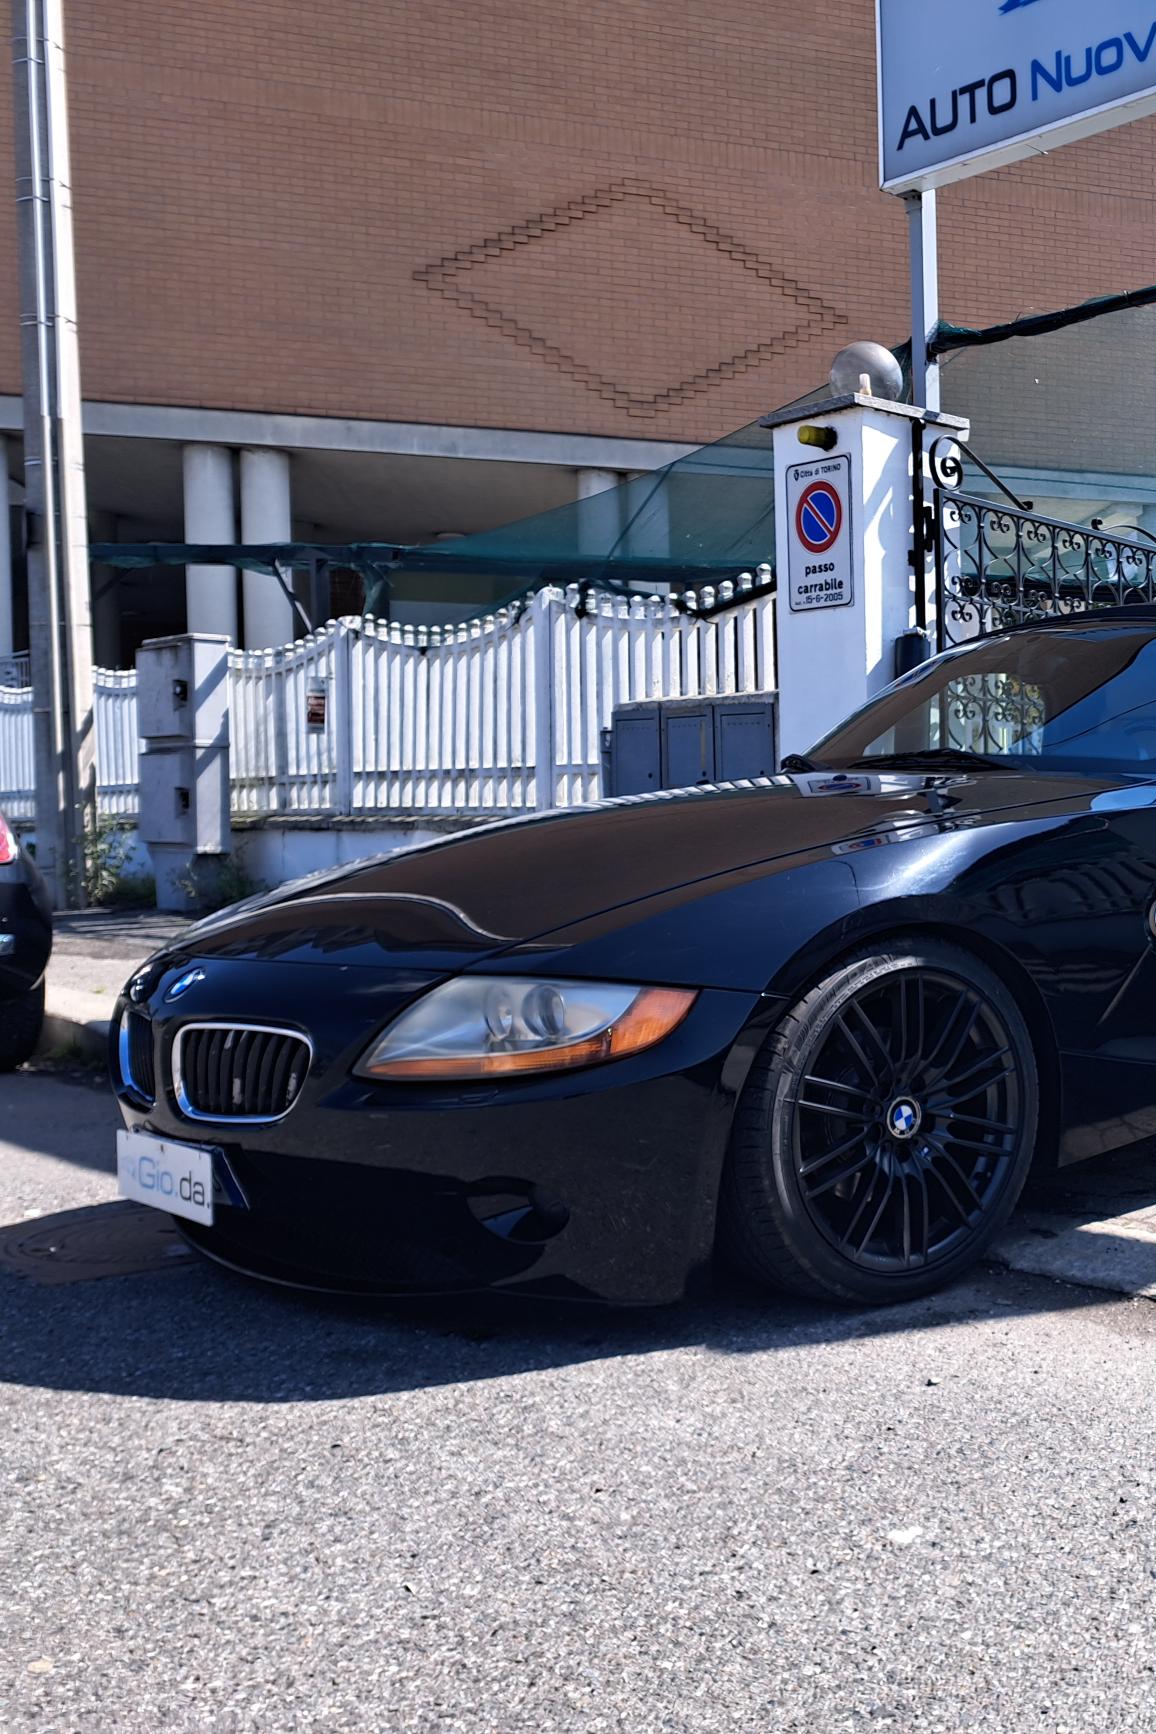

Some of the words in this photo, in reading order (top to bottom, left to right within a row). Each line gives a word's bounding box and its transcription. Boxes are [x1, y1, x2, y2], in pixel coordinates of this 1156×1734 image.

[896, 68, 1017, 151] AUTO
[820, 463, 841, 474] TORINO
[805, 562, 835, 577] passo
[797, 578, 843, 595] carrabile
